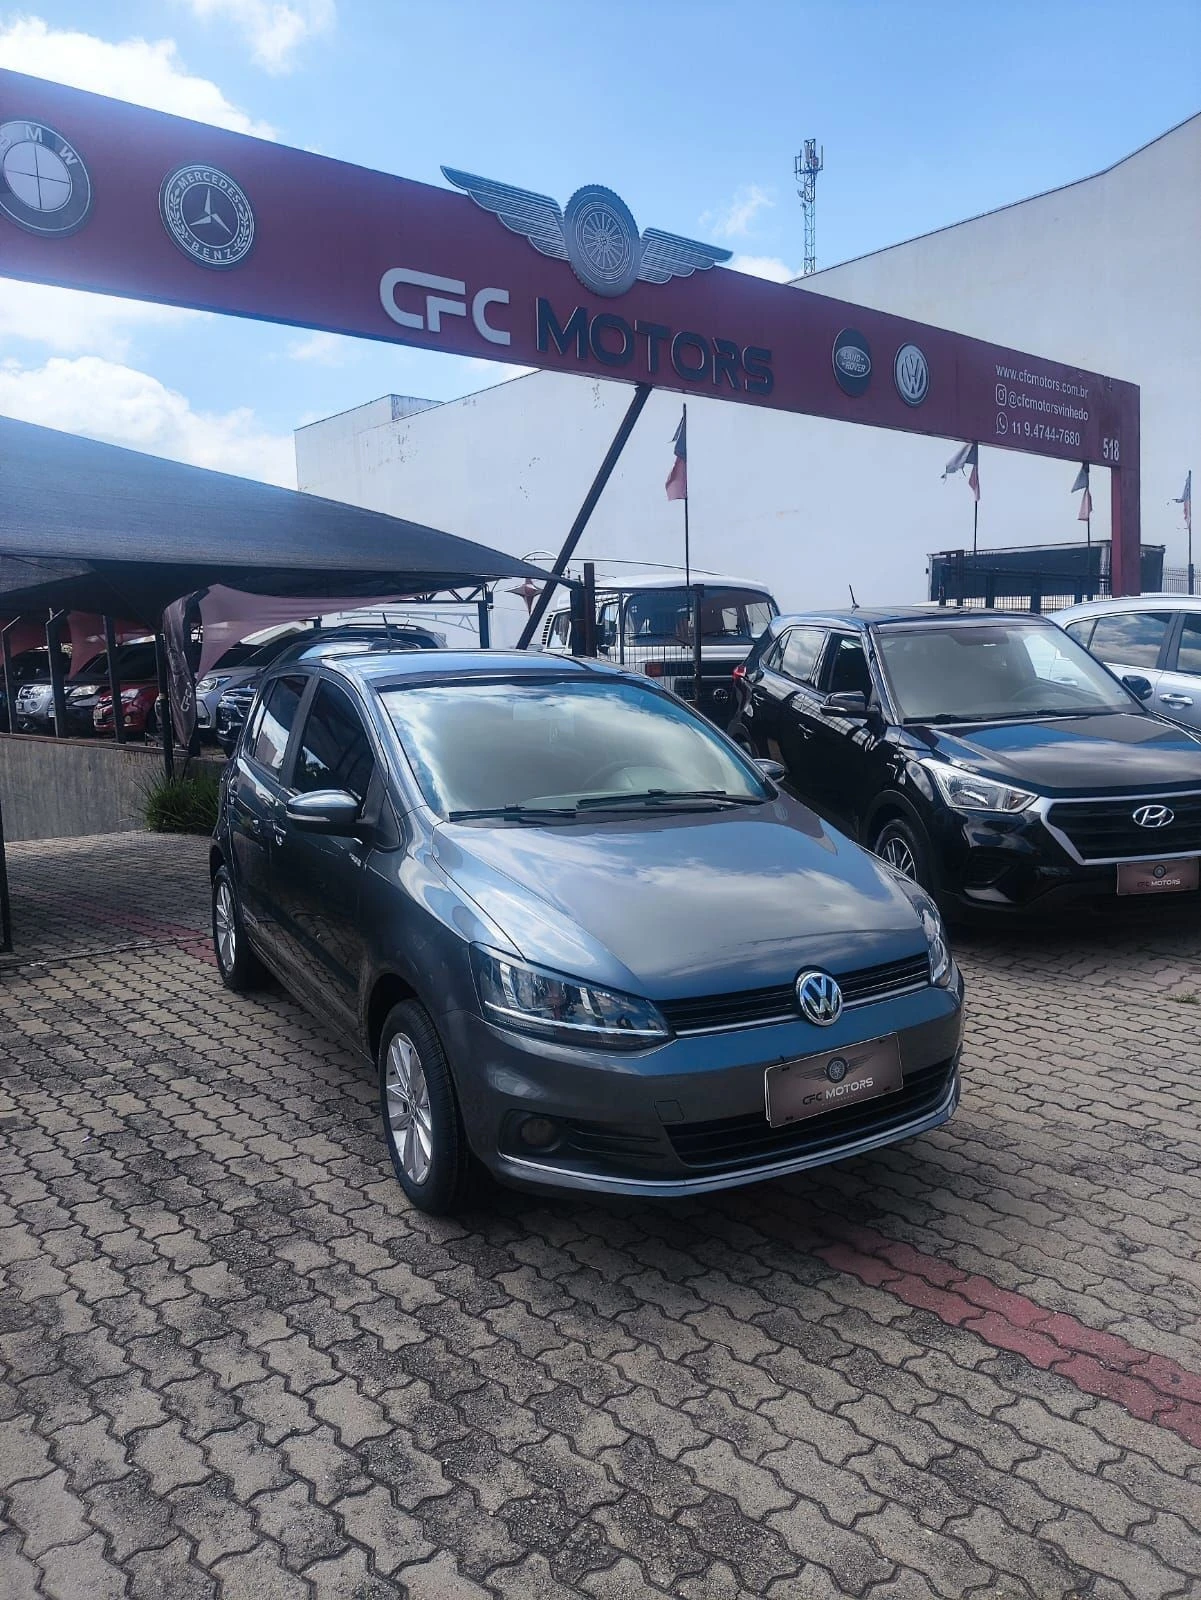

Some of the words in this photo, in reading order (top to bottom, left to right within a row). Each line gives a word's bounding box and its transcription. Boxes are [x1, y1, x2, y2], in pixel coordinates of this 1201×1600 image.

[177, 171, 241, 203] MERCEDES
[191, 241, 233, 260] BENZ
[379, 267, 511, 345] CFC
[536, 297, 773, 395] MOTORS
[995, 364, 1089, 399] www.cfcmotors.com.br
[1008, 391, 1089, 421] @cfcmotorsvinhedo
[1011, 422, 1021, 434] 11
[1024, 422, 1081, 446] 9.4744-7680
[1103, 438, 1120, 461] 518
[802, 1091, 823, 1106] CFC
[825, 1077, 874, 1100] MOTORS
